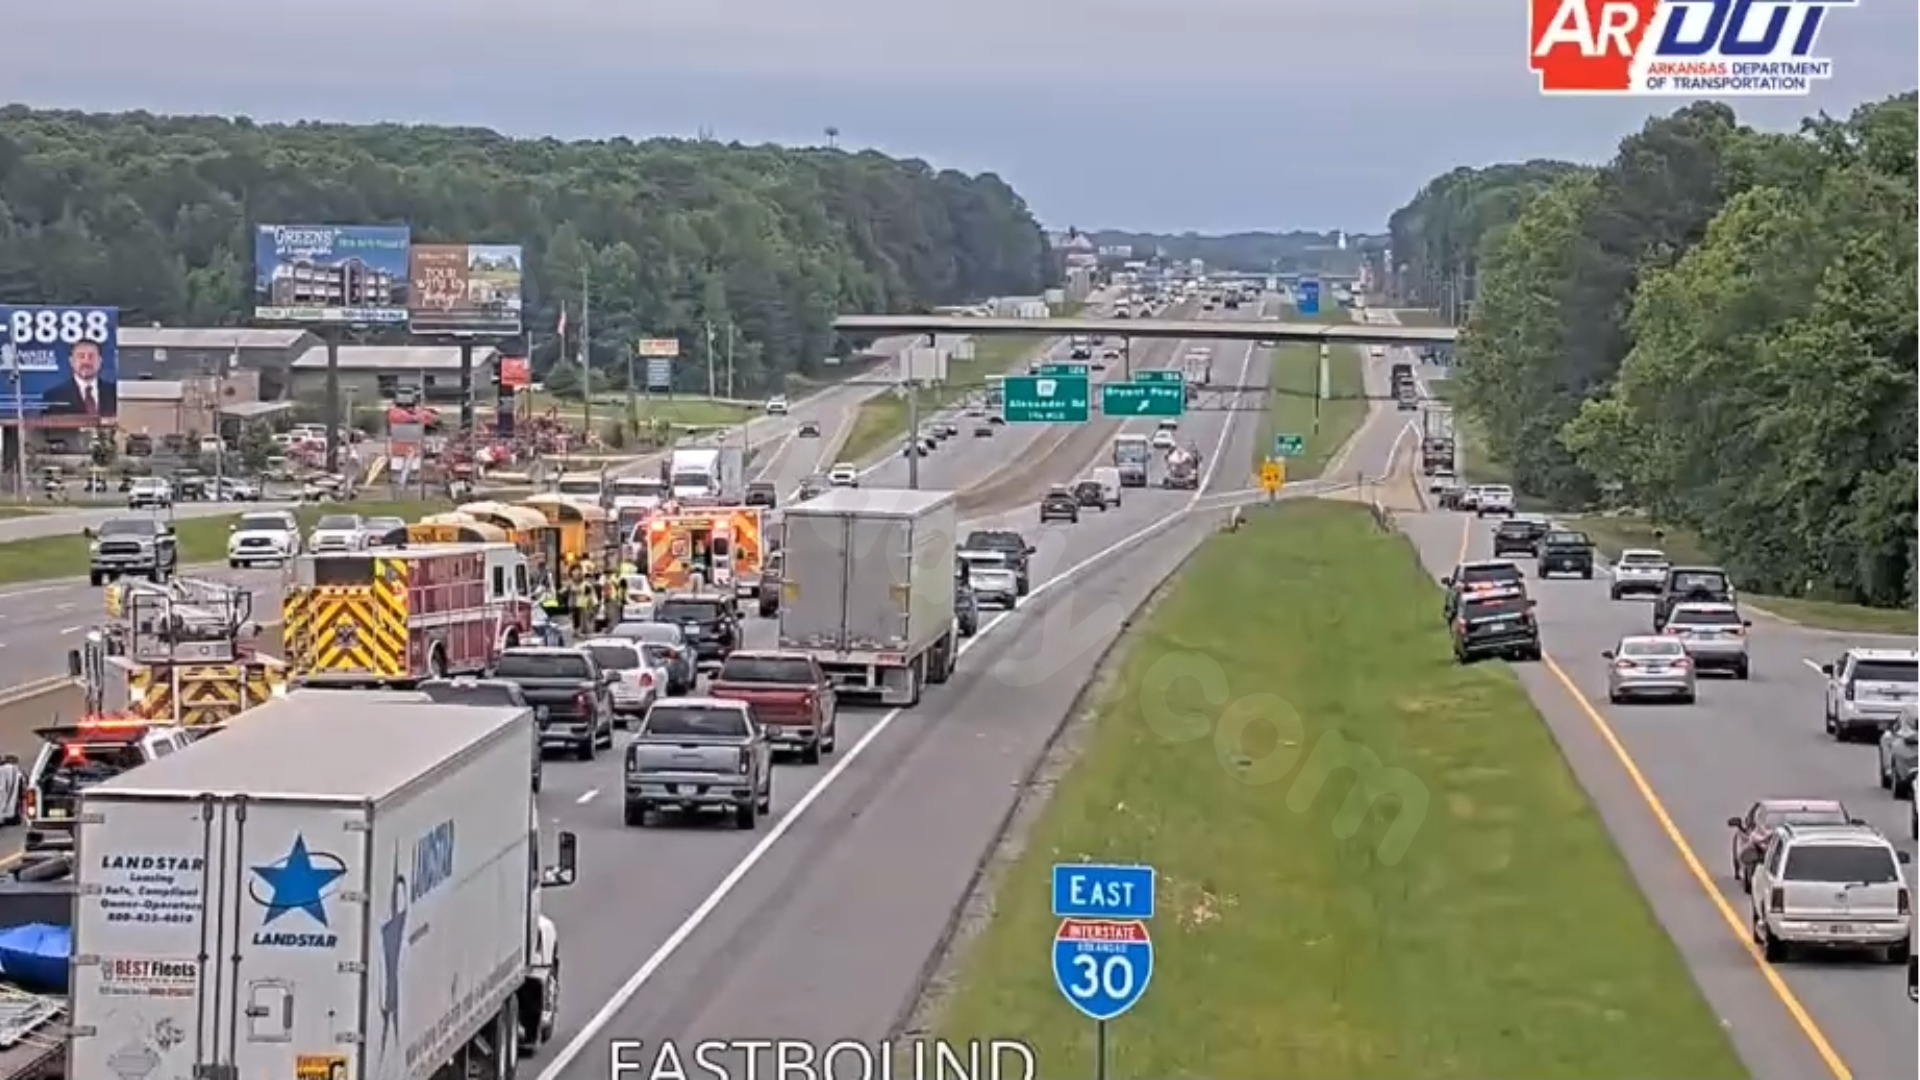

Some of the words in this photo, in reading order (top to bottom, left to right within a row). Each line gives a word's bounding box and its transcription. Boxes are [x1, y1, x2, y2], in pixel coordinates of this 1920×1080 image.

[101, 856, 205, 871] LANDSTAR
[130, 873, 175, 884] Leasing
[1070, 875, 1135, 907] EAST
[252, 932, 338, 948] LANDSTAR
[1067, 925, 1136, 940] INTERSTATE
[115, 960, 149, 975] BEST
[151, 961, 196, 977] Fleets
[1070, 953, 1134, 999] 30
